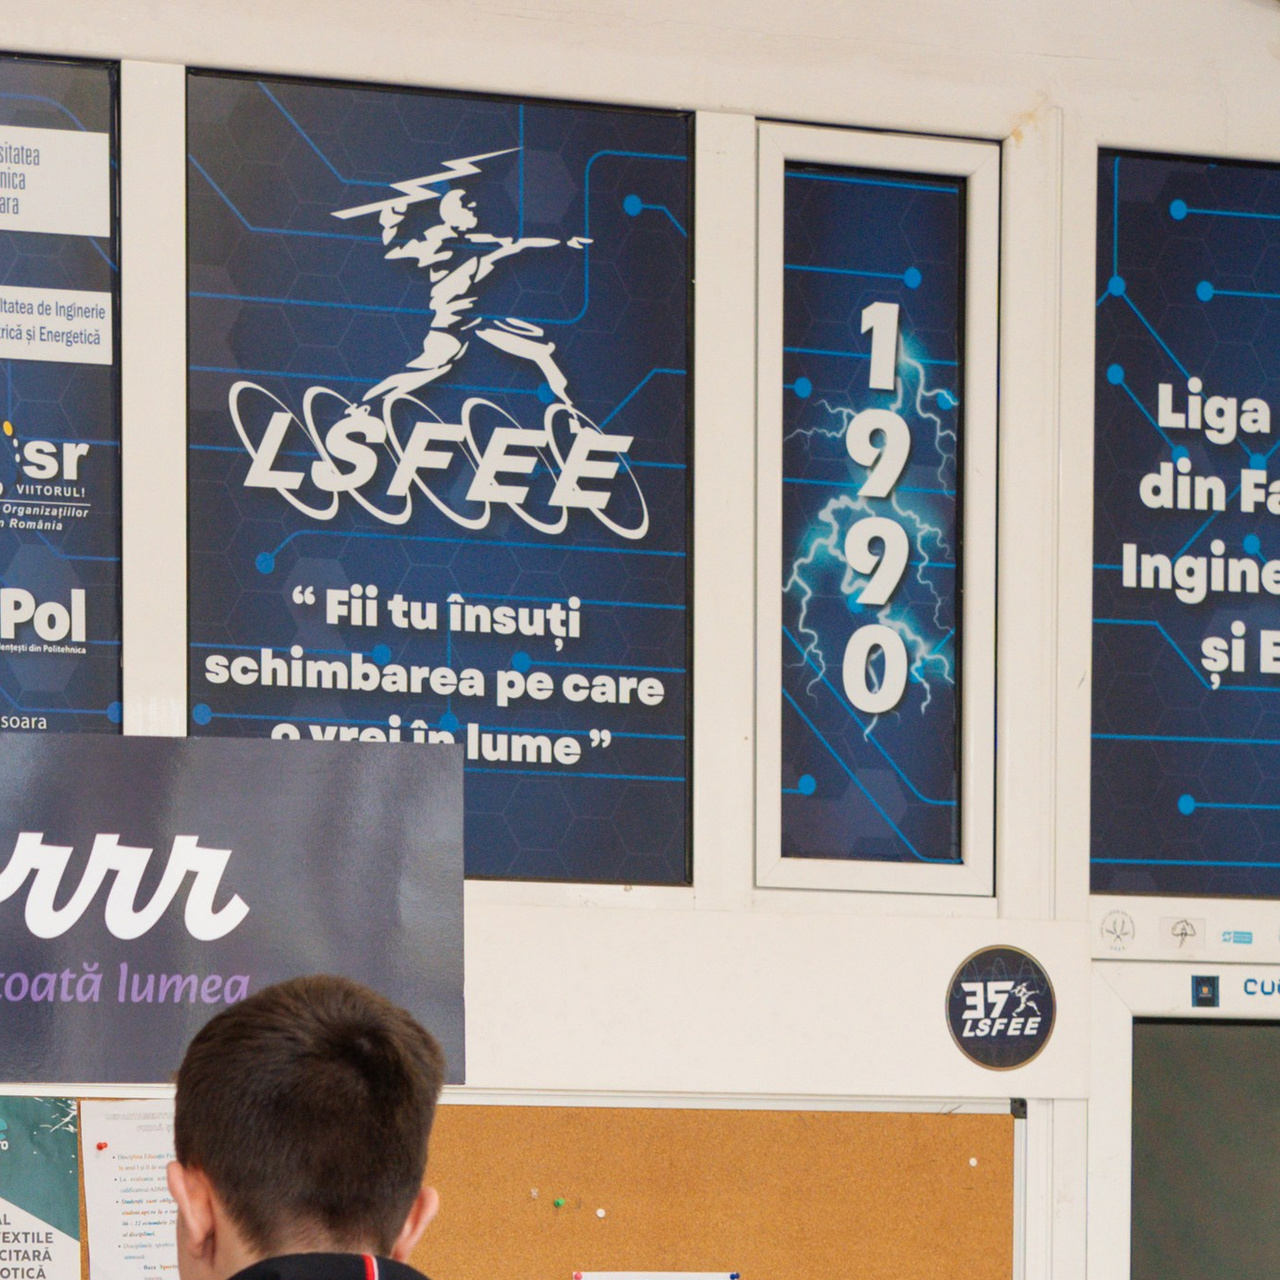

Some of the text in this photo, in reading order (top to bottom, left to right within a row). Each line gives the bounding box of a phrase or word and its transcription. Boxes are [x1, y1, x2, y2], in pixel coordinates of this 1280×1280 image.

[37, 301, 52, 316] de
[55, 301, 106, 321] Inginerie
[26, 326, 36, 345] și
[39, 327, 101, 347] Energetică
[1158, 376, 1271, 445] Liga
[242, 411, 634, 510] LSFEE
[16, 484, 86, 498] VIITORUL!
[1139, 456, 1227, 512] din
[2, 503, 89, 519] Organizațiilor
[9, 518, 64, 531] România
[1122, 539, 1280, 605] Ingine
[387, 593, 438, 630] tu
[447, 593, 582, 652] însuți
[28, 643, 41, 653] din
[1200, 620, 1246, 691] și
[204, 645, 665, 707] schimbarea pe care
[117, 961, 251, 1004] lumea
[962, 1017, 1042, 1038] LSFEE
